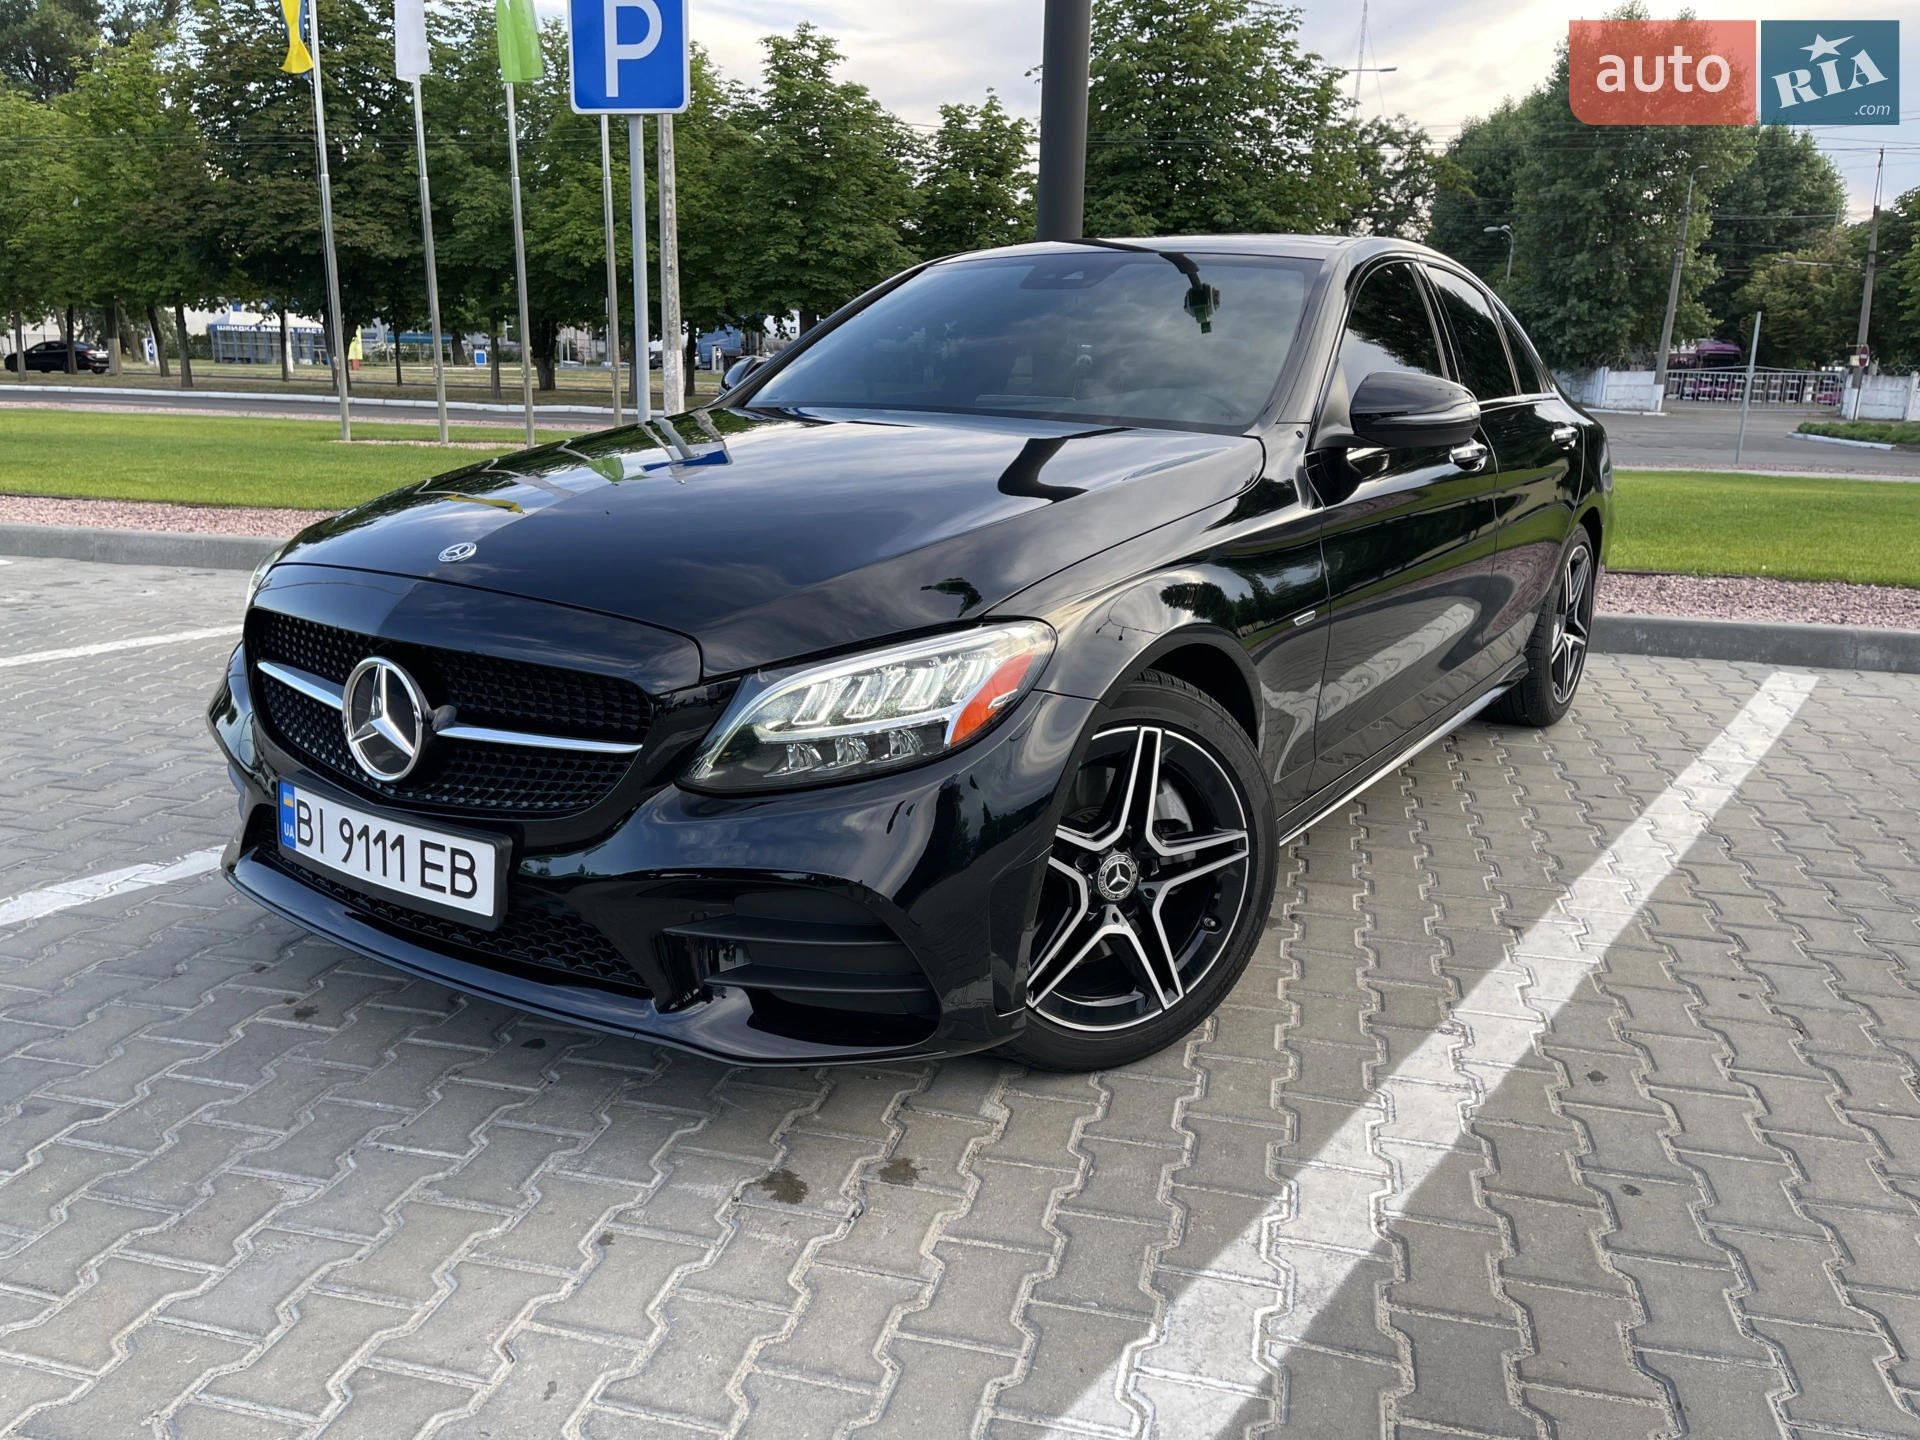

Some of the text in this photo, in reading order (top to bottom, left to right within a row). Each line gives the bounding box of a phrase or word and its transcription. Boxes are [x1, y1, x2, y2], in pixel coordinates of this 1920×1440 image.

[603, 0, 663, 98] P
[283, 822, 295, 840] UA
[296, 798, 478, 900] BI 9111 EB
